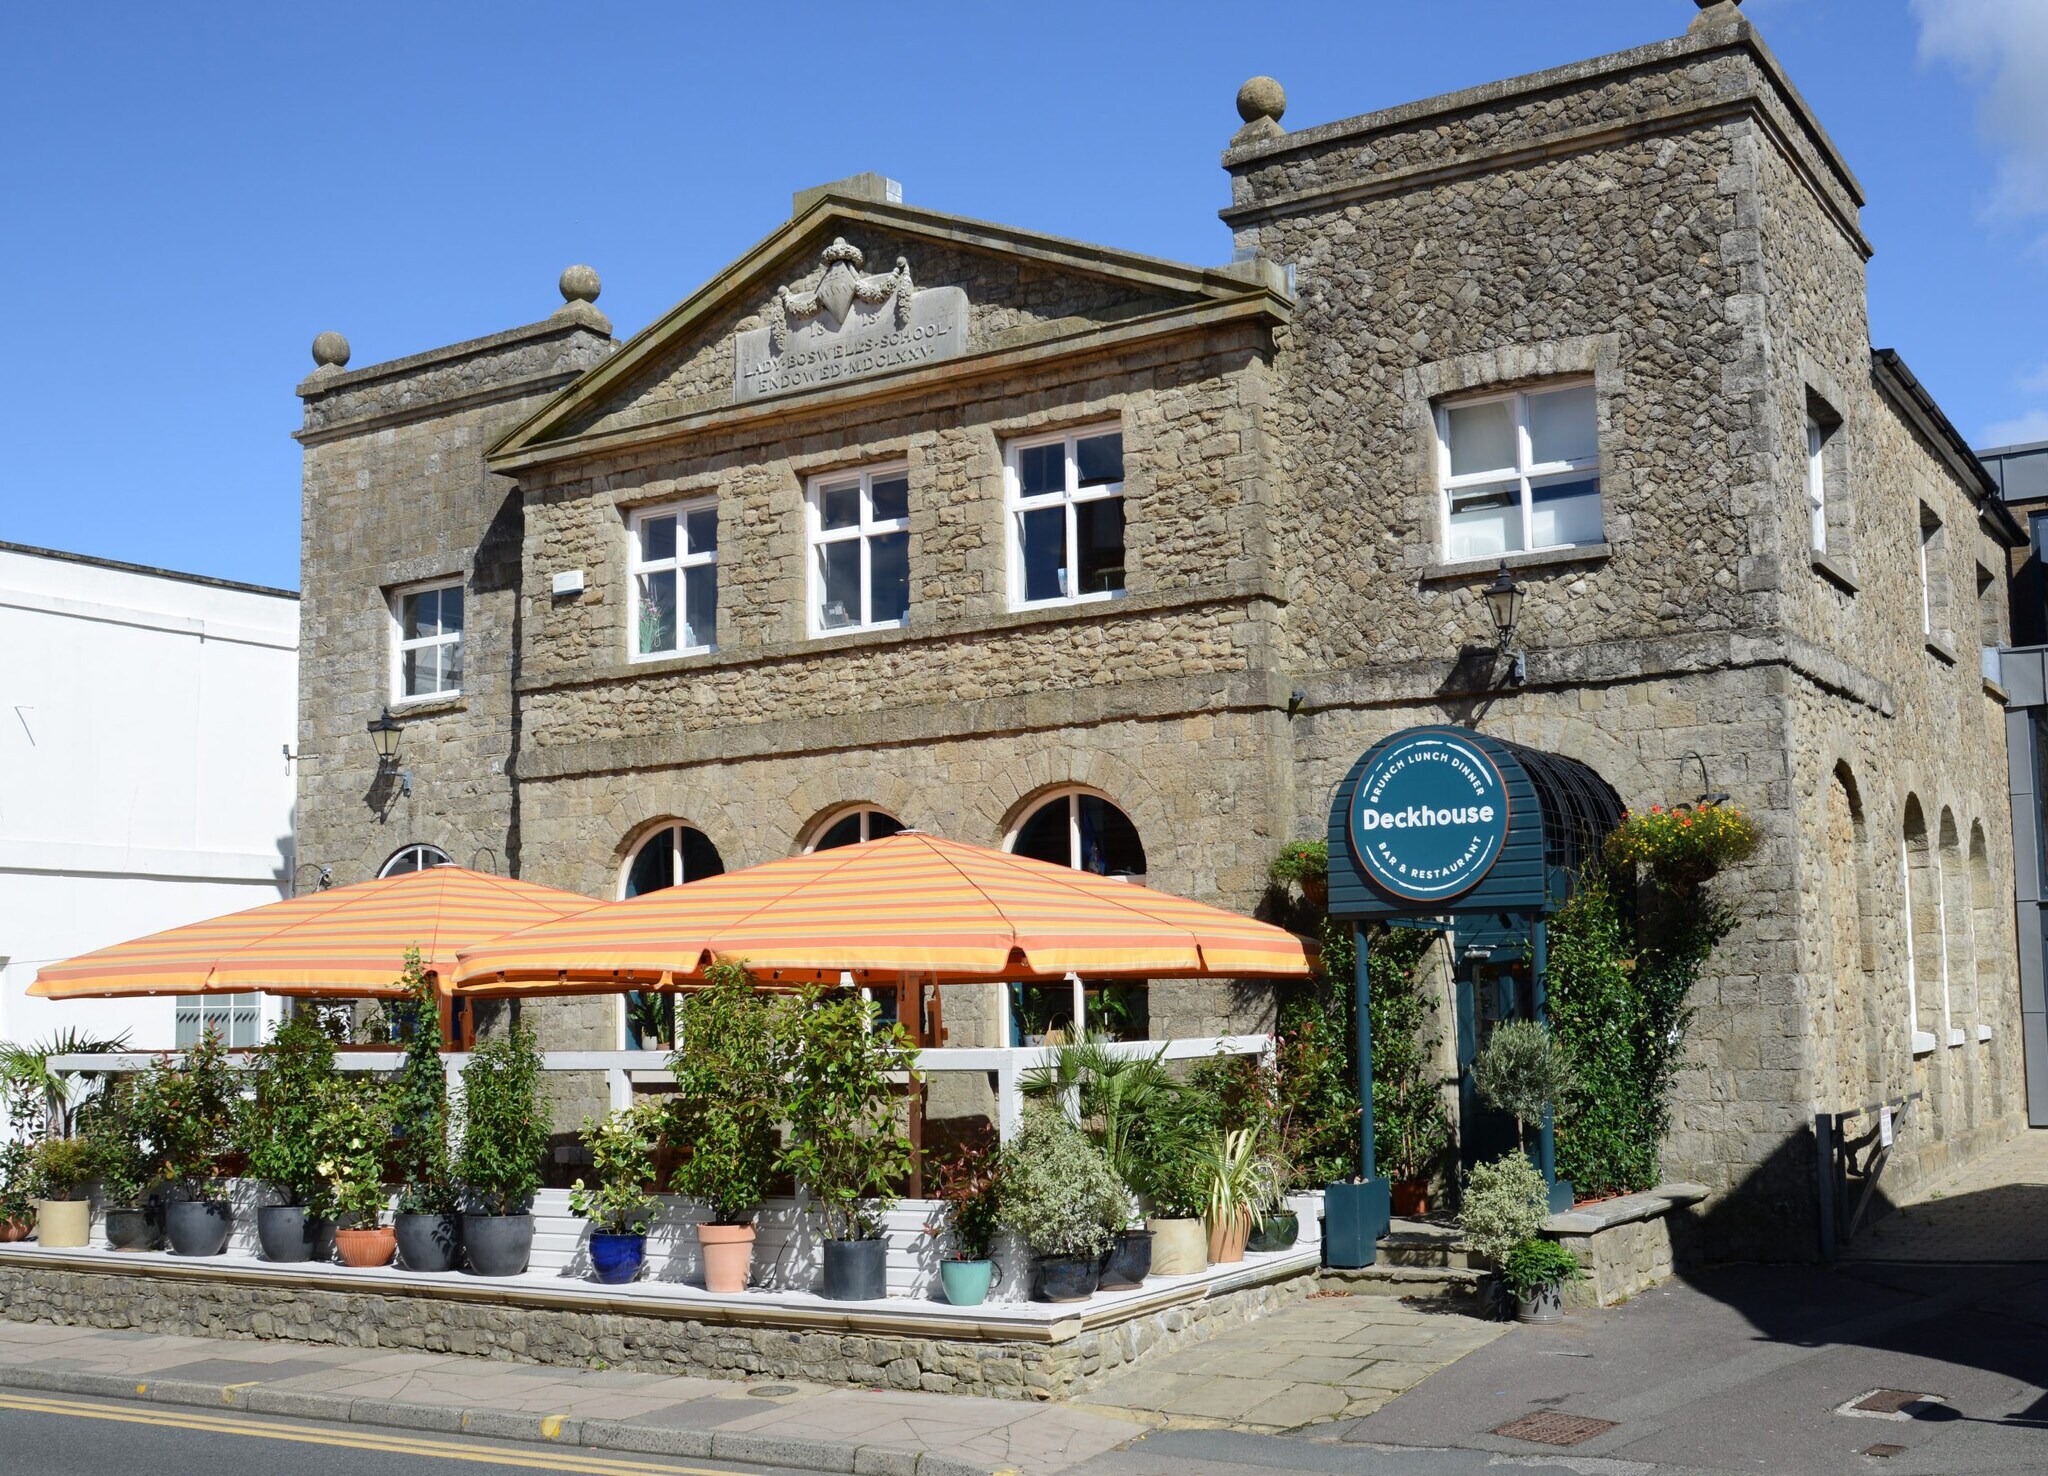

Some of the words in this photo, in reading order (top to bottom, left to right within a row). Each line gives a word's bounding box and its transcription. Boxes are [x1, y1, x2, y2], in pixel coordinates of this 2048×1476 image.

[1370, 759, 1406, 804] BRUNCH
[1408, 751, 1449, 764] LUNCH
[1451, 757, 1485, 797] DINNER
[1363, 805, 1494, 830] Deckhouse
[1378, 841, 1398, 866] BAR
[1398, 863, 1407, 874] &
[1410, 835, 1482, 879] RESTAURANT
